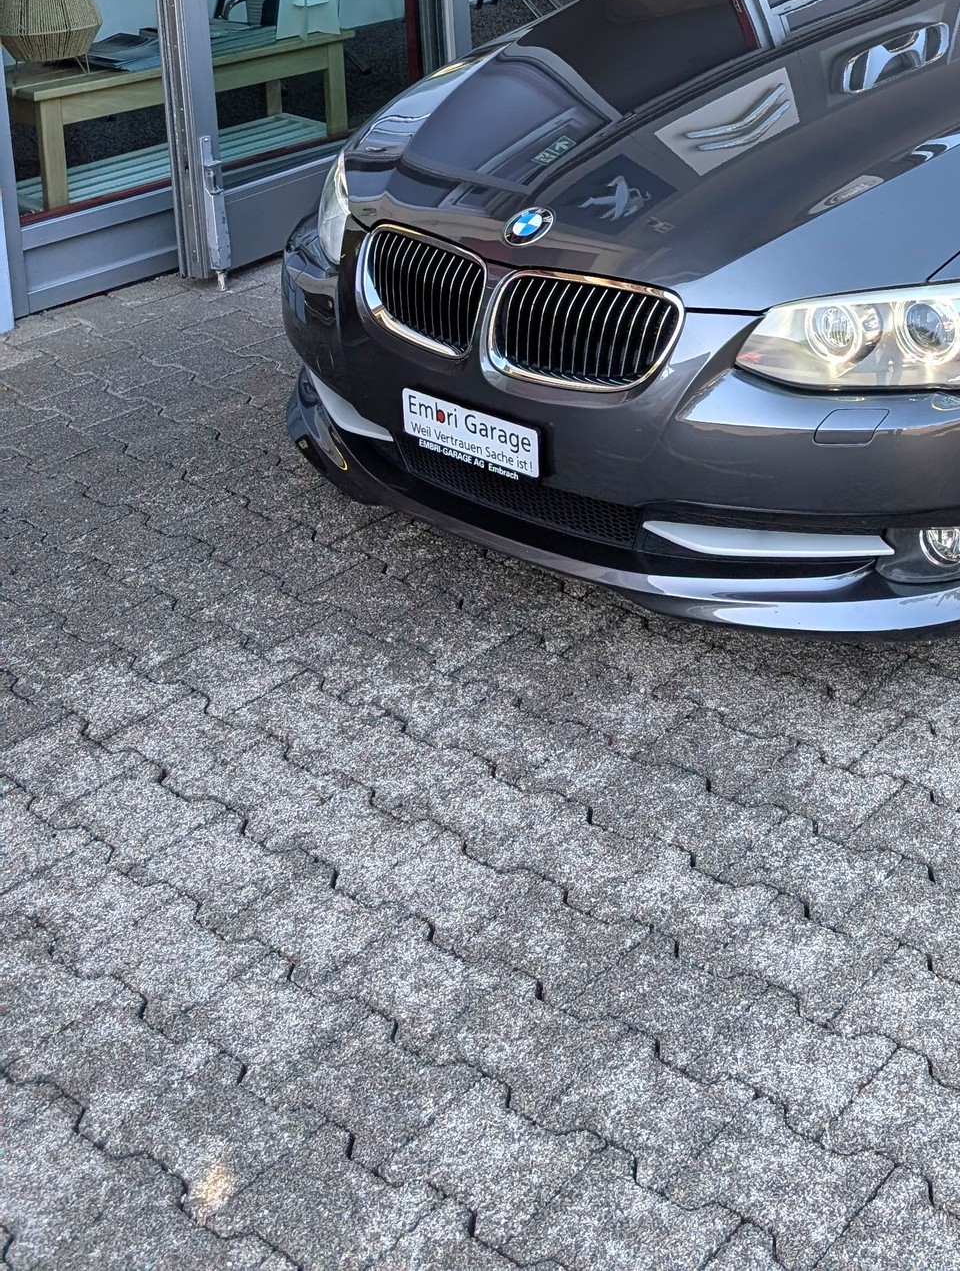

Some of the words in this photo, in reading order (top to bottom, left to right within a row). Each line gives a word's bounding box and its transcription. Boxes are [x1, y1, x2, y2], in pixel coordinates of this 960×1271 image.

[408, 394, 458, 429] Embri
[464, 414, 532, 454] Garage
[410, 421, 432, 437] Weil
[434, 426, 483, 455] Vertrauen
[485, 446, 514, 466] Sache
[418, 438, 473, 464] EMBRI-GARAGE
[473, 458, 485, 469] AG
[488, 463, 519, 480] Embrach
